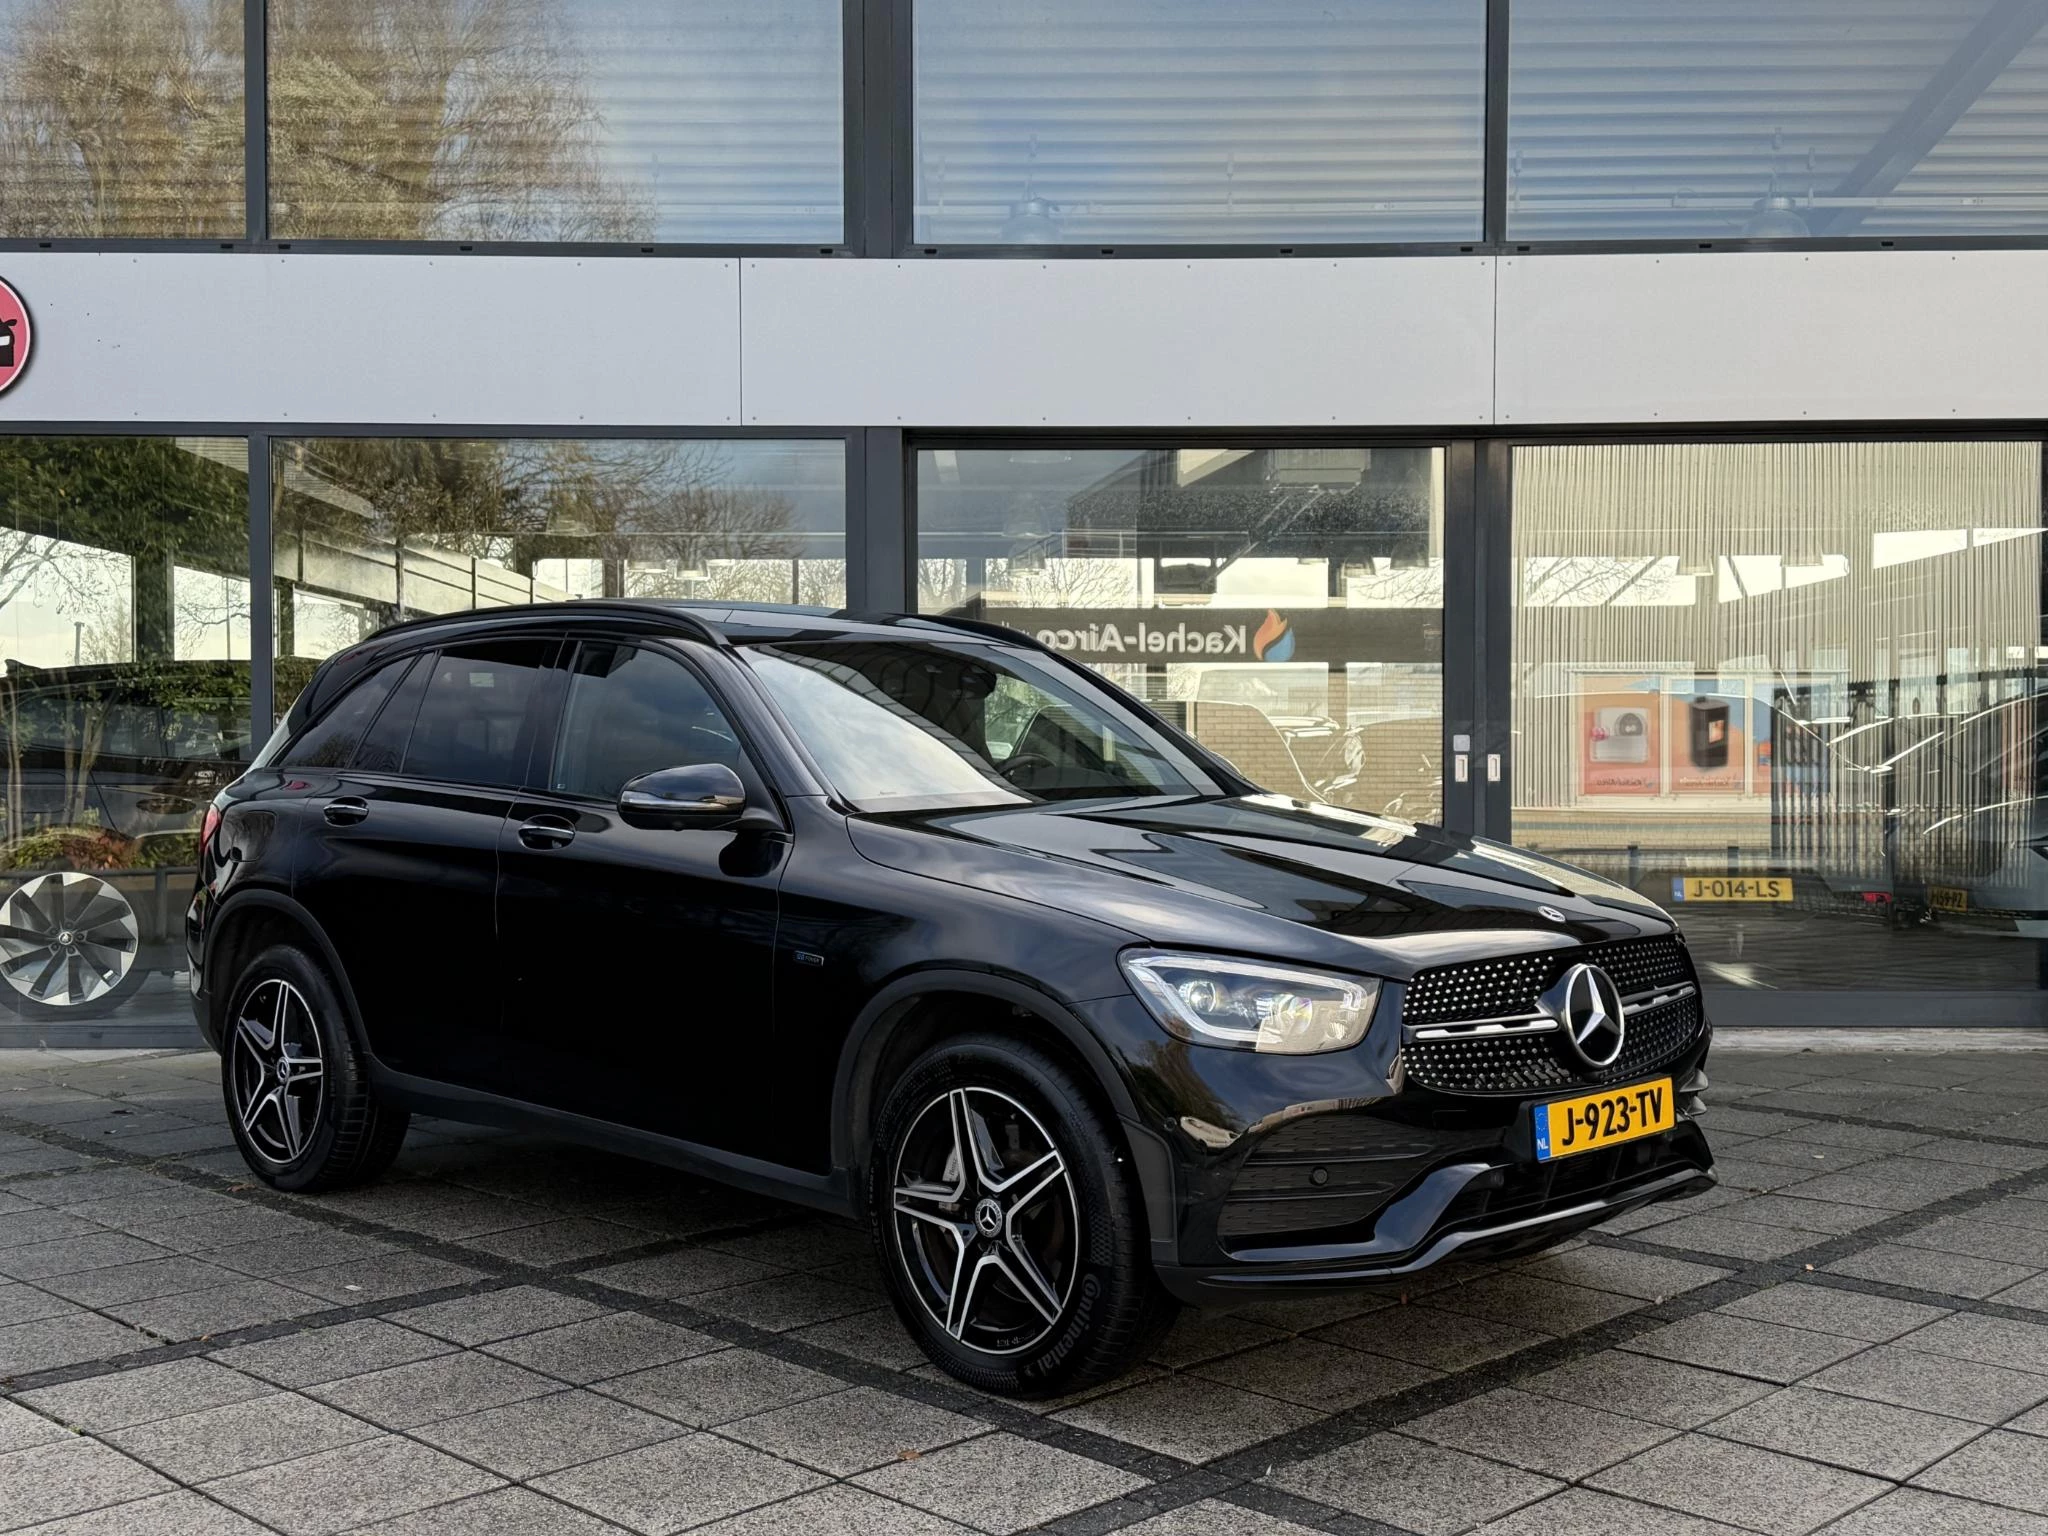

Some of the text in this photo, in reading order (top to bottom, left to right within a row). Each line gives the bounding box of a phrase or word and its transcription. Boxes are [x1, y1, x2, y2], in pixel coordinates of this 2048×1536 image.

[1693, 880, 1780, 898] J-014-LS
[1562, 1087, 1663, 1146] J-923-TV
[1537, 1137, 1549, 1151] NL
[1037, 1273, 1102, 1377] Continental
